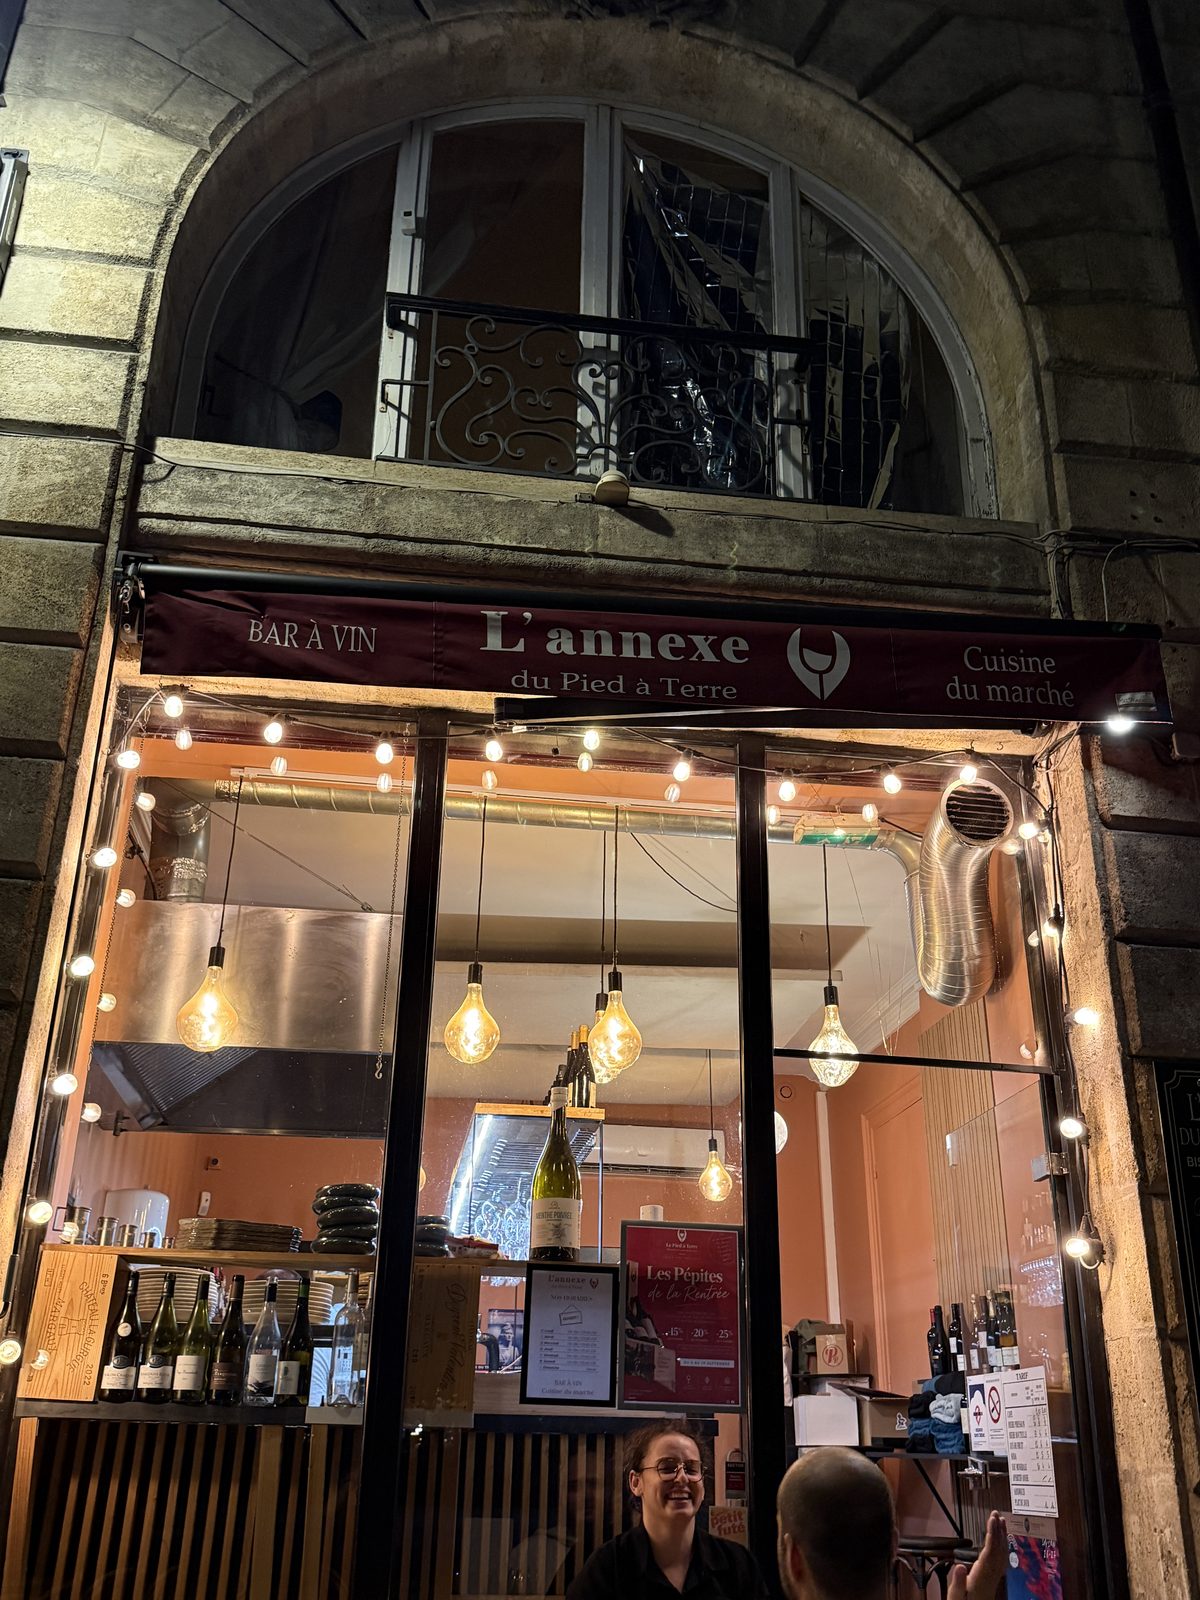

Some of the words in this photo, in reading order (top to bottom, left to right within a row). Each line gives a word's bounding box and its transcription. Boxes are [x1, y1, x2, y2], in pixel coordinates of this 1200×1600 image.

[248, 619, 299, 648] BAR
[305, 618, 324, 650] À
[331, 624, 377, 653] VIN
[963, 645, 1056, 674] Cuisine
[511, 669, 551, 690] du
[560, 672, 626, 694] Pied
[636, 678, 651, 695] à
[659, 677, 737, 699] Terre
[946, 675, 980, 701] du
[985, 681, 1075, 707] marché
[647, 1265, 671, 1281] Les
[674, 1267, 723, 1285] Pépites
[648, 1283, 663, 1302] de
[666, 1284, 680, 1300] la
[684, 1284, 730, 1302] Rentrée
[83, 1364, 94, 1386] 2022
